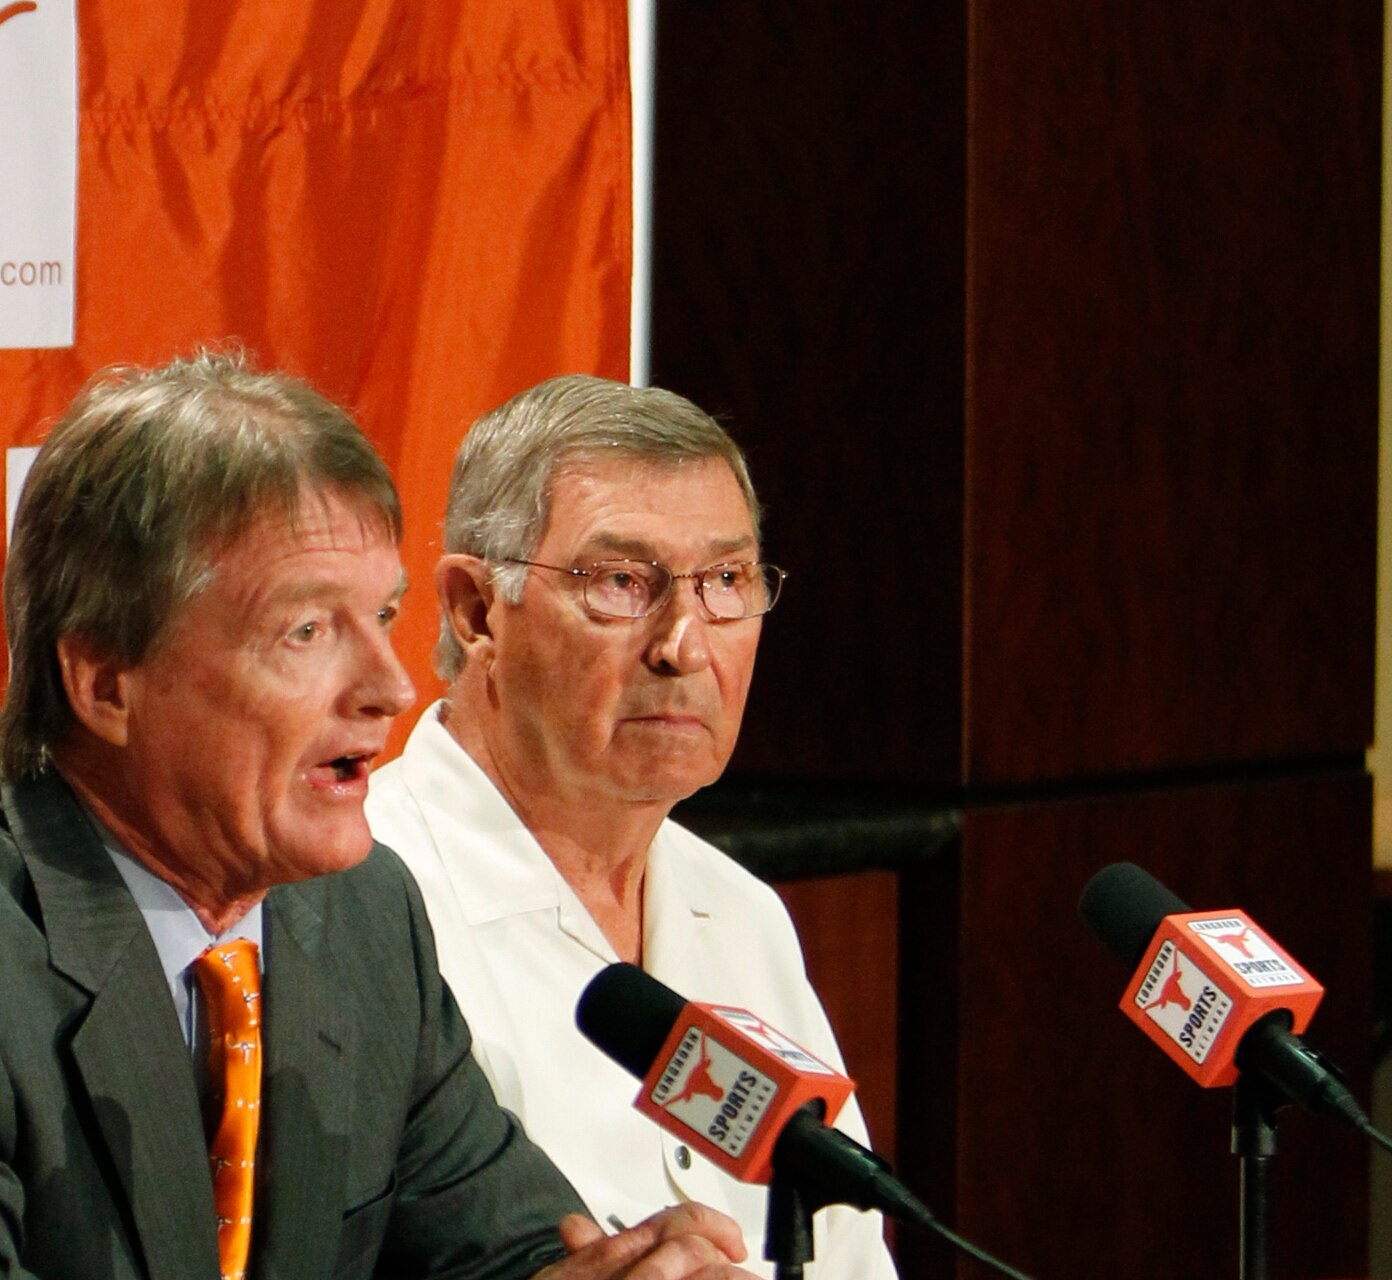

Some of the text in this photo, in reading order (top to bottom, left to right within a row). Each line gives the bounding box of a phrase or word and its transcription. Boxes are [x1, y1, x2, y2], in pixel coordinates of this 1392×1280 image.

[1234, 959, 1286, 975] SPORTS
[1179, 986, 1218, 1048] SPORTS
[708, 1070, 758, 1142] SPORTS
